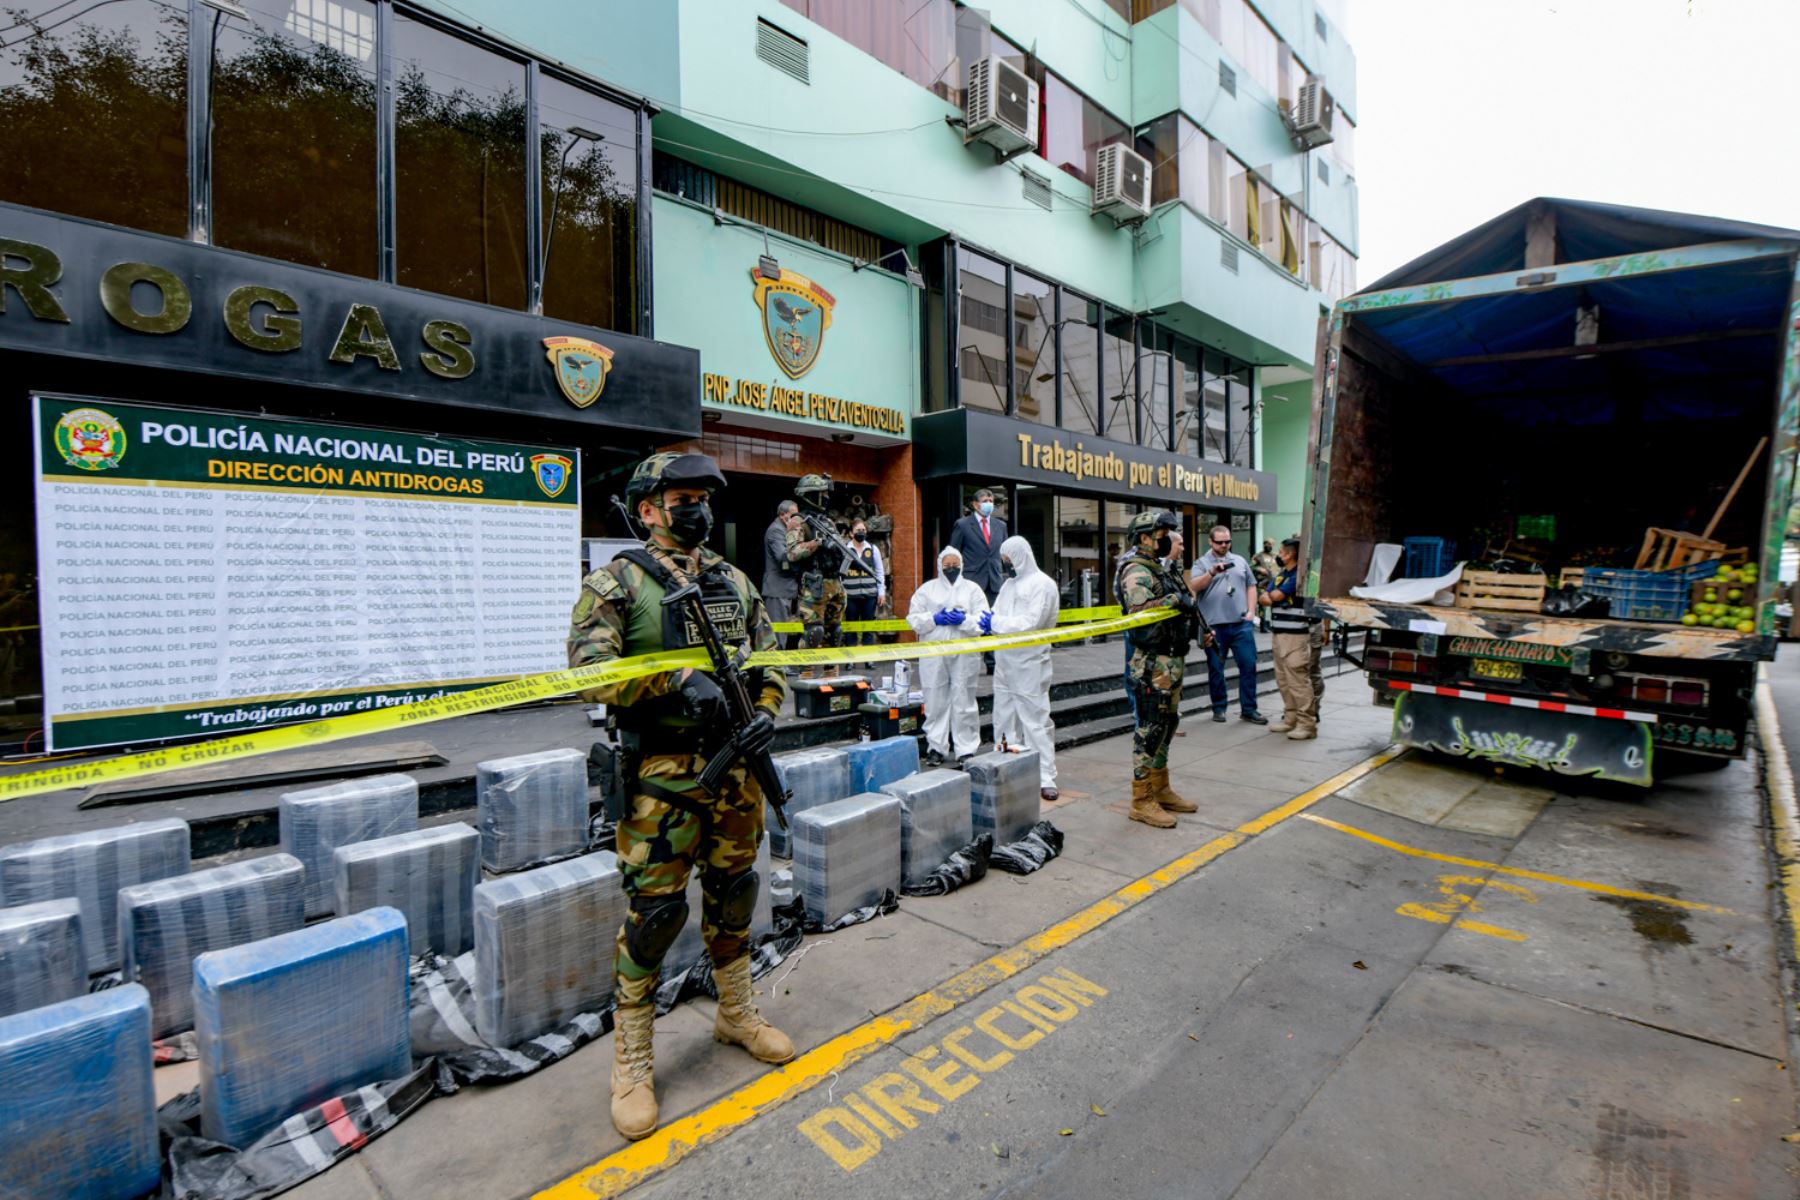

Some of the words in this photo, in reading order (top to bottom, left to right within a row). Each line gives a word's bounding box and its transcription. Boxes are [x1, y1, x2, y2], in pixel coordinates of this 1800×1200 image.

[0, 237, 475, 378] ROGAS
[141, 421, 269, 452] POLICÍA
[274, 433, 412, 464] NACIONAL
[417, 447, 462, 469] DEL
[467, 452, 525, 474] PERÚ
[1018, 433, 1124, 481] Trabajando
[1129, 462, 1154, 489] por
[1158, 462, 1171, 488] el
[1175, 464, 1203, 493] Perú
[1213, 473, 1223, 496] el
[1224, 473, 1259, 500] Mundo
[208, 459, 343, 485] DIRECCIÓN
[349, 469, 484, 494] ANTIDROGAS
[104, 488, 159, 498] NACIONAL
[163, 491, 182, 499] DEL
[104, 506, 159, 516] NACIONAL
[163, 508, 182, 516] DEL
[105, 523, 160, 533] NACIONAL
[164, 525, 183, 533] DEL
[106, 541, 160, 551] NACIONAL
[164, 542, 183, 550] DEL
[106, 558, 161, 568] NACIONAL
[165, 559, 184, 567] DEL
[107, 575, 161, 585] NACIONAL
[165, 575, 185, 583] DEL
[108, 592, 162, 603] NACIONAL
[166, 592, 185, 600] DEL
[108, 610, 163, 620] NACIONAL
[166, 609, 186, 617] DEL
[109, 628, 163, 638] NACIONAL
[167, 626, 186, 634] DEL
[110, 645, 164, 655] NACIONAL
[167, 643, 187, 651] DEL
[110, 662, 164, 672] NACIONAL
[168, 660, 187, 668] DEL
[111, 680, 165, 690] NACIONAL
[168, 677, 188, 685] DEL
[475, 678, 540, 698] NACIONAL
[545, 673, 568, 685] DEL
[112, 697, 165, 707] NACIONAL
[169, 693, 188, 701] DEL
[320, 701, 353, 716] por
[356, 695, 372, 710] el
[375, 692, 413, 709] Perú
[400, 708, 439, 722] ZONA
[449, 690, 537, 714] RESTRINGIDA
[554, 681, 571, 692] NO
[138, 757, 167, 770] NO
[180, 741, 255, 762] CRUZAR
[797, 966, 1109, 1173] DIRECCION
